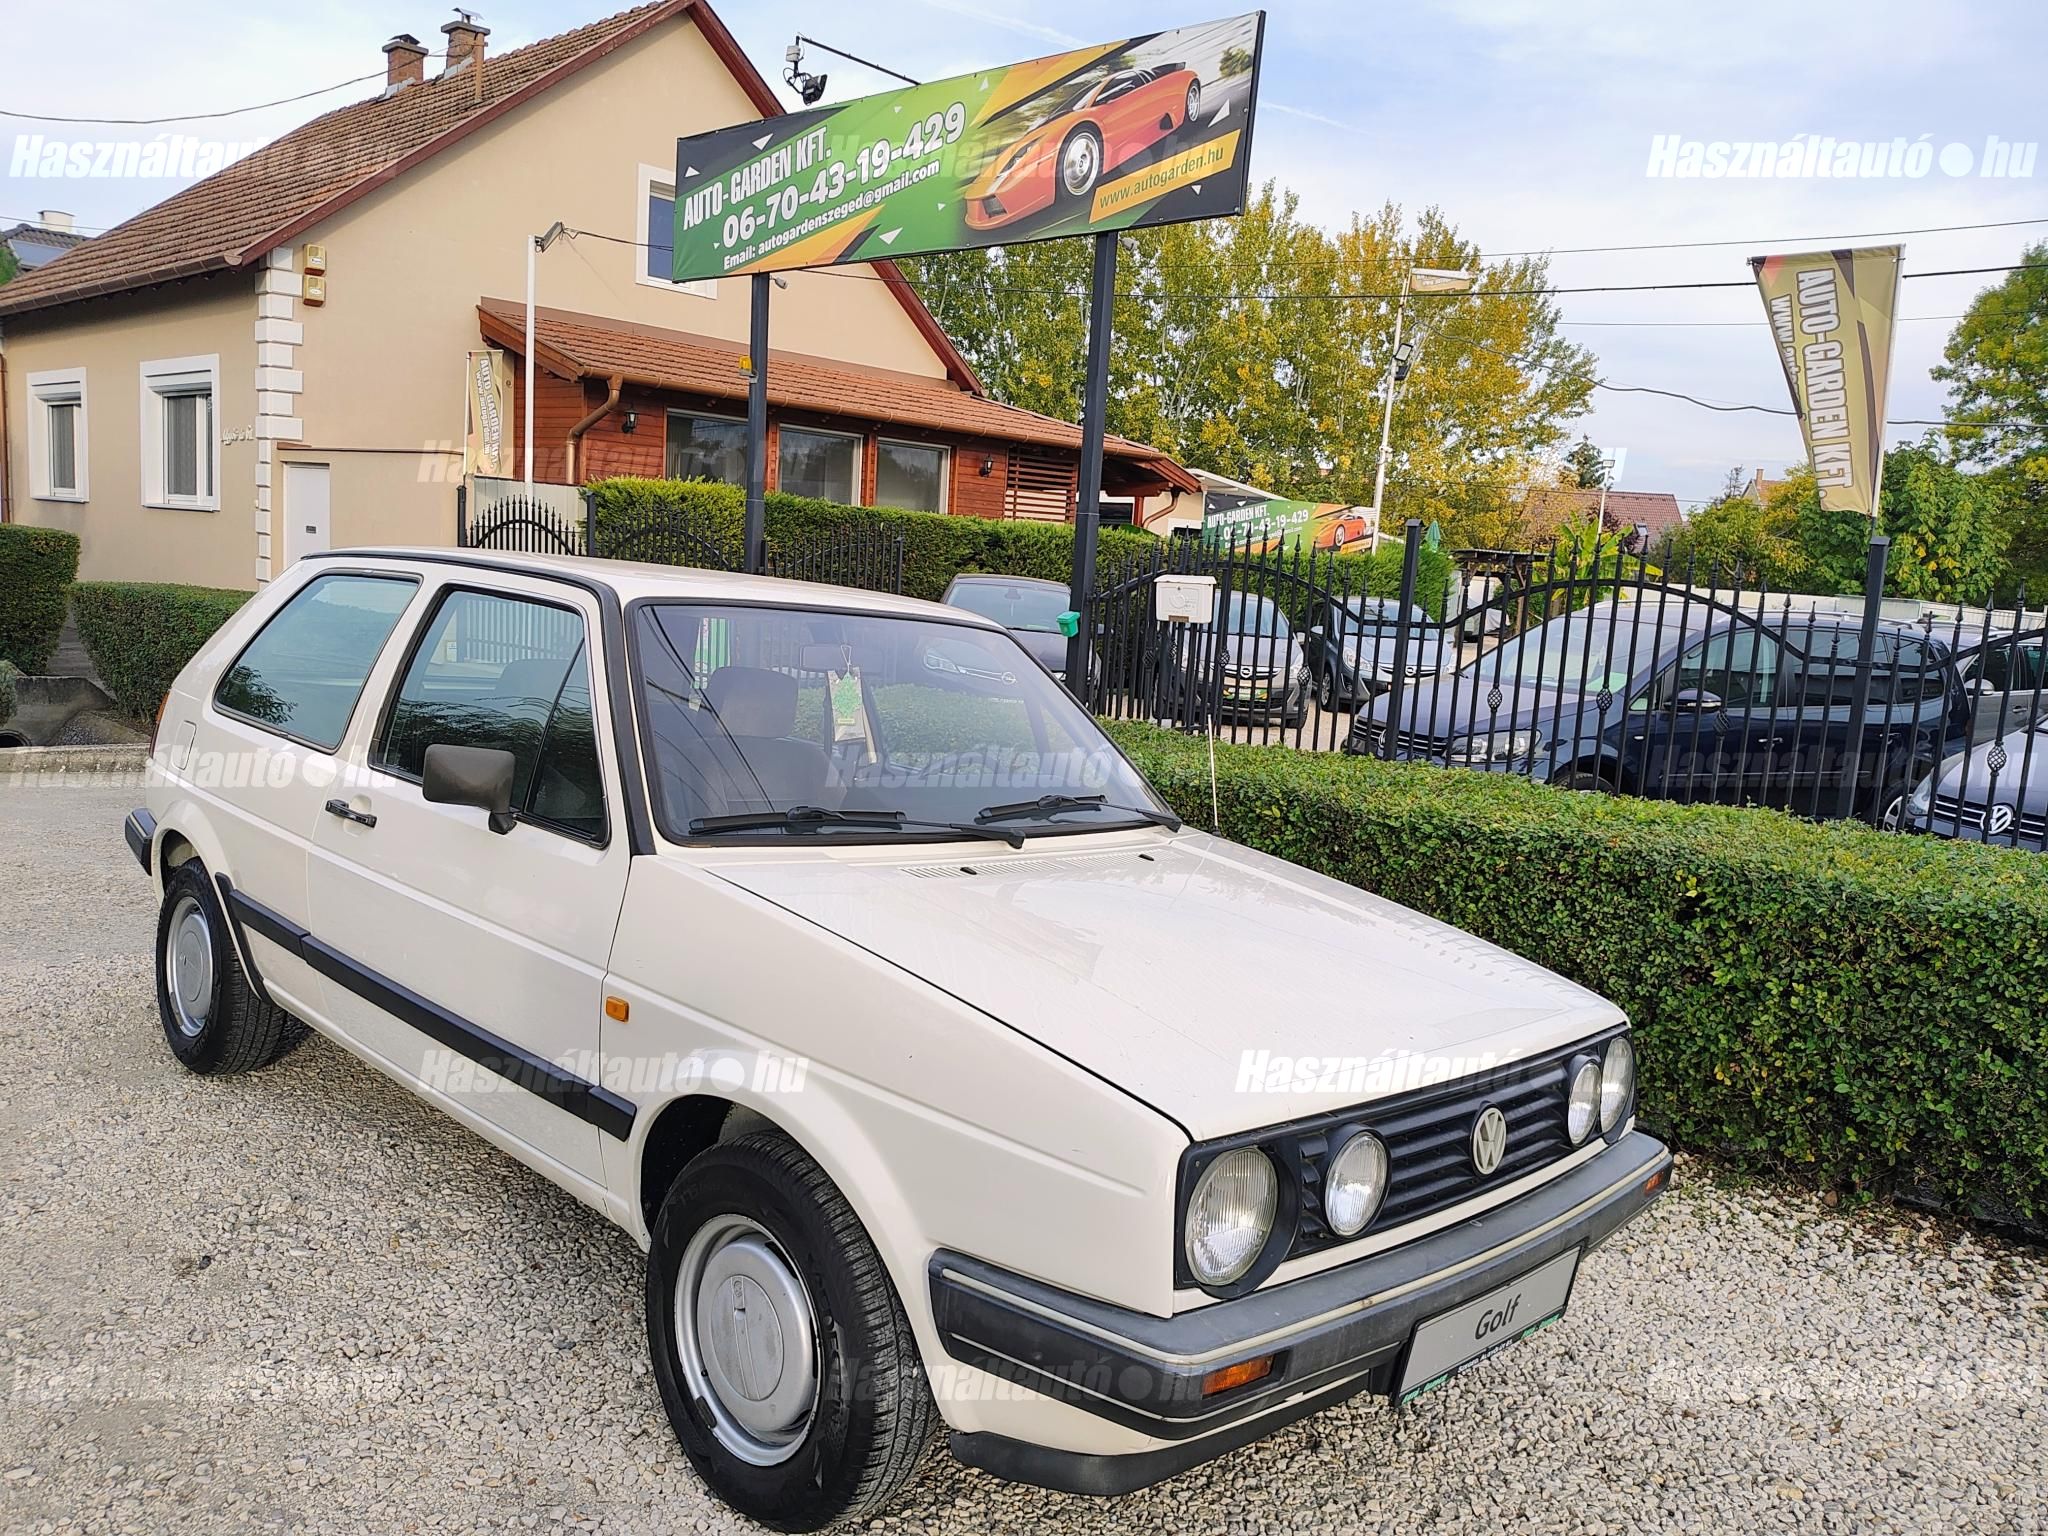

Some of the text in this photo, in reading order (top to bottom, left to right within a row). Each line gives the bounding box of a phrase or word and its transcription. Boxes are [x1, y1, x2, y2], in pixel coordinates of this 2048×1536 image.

[683, 126, 831, 231] AUTO-GARDEN KFT.
[723, 102, 966, 248] 06-70-43-19-429
[724, 159, 940, 271] Email: autogardenszeged@gmail.com
[1100, 147, 1224, 209] www.autogarden.hu
[1796, 268, 1854, 499] AUTO-GARDEN KFT.
[1474, 1293, 1522, 1340] Golf
